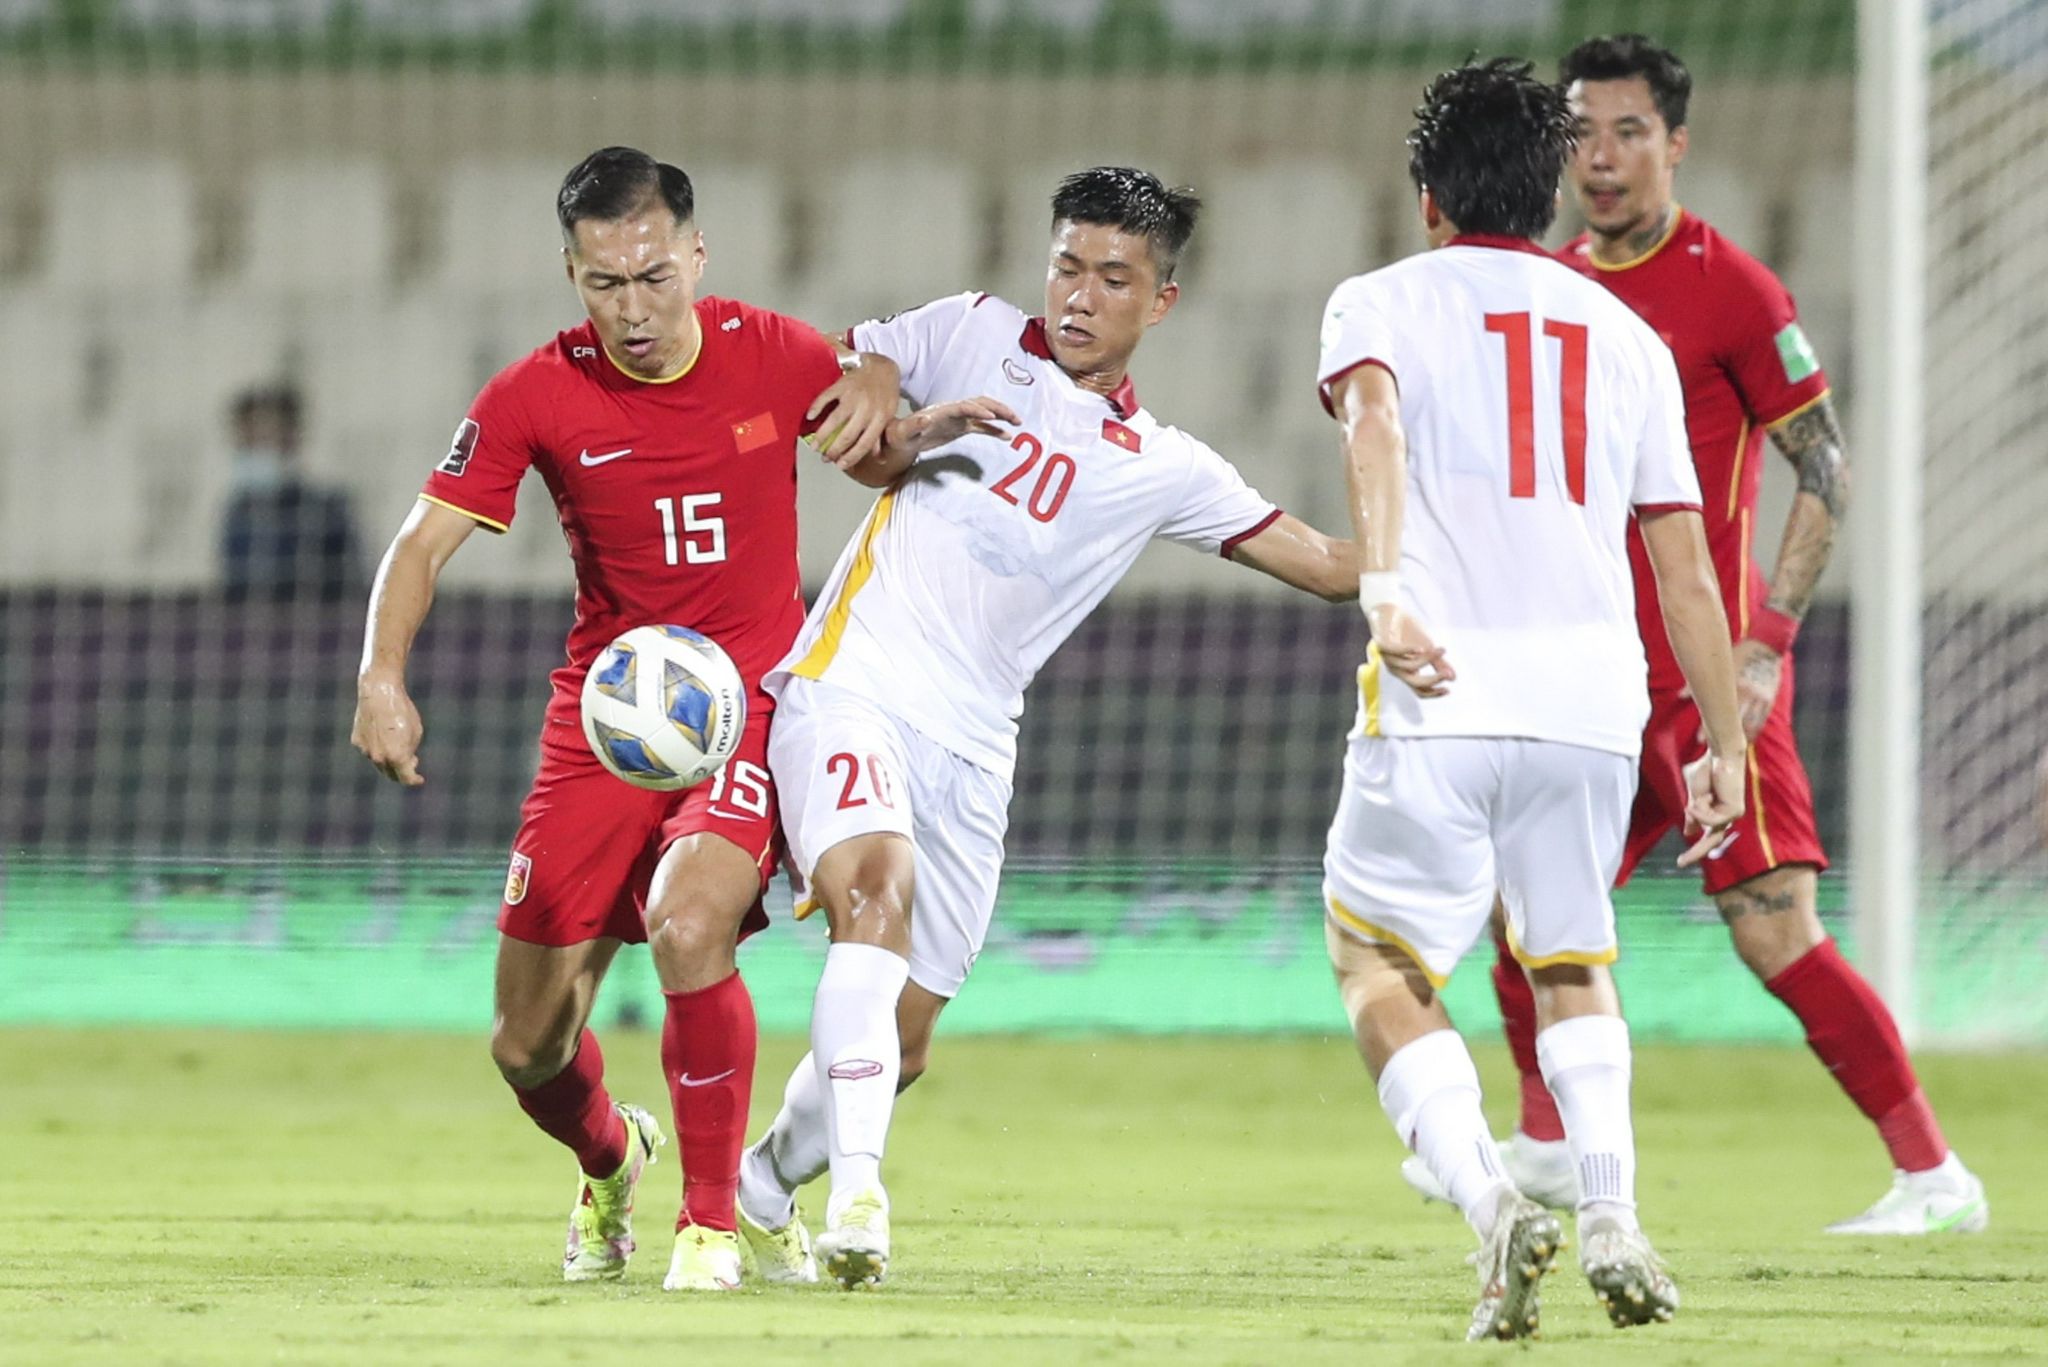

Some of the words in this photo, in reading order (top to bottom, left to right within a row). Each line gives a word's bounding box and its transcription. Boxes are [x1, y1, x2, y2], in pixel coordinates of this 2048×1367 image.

[1484, 311, 1588, 506] 11
[989, 432, 1077, 523] 20
[654, 491, 726, 565] 15
[716, 688, 732, 752] molten
[709, 760, 769, 818] 15
[827, 752, 894, 810] 20
